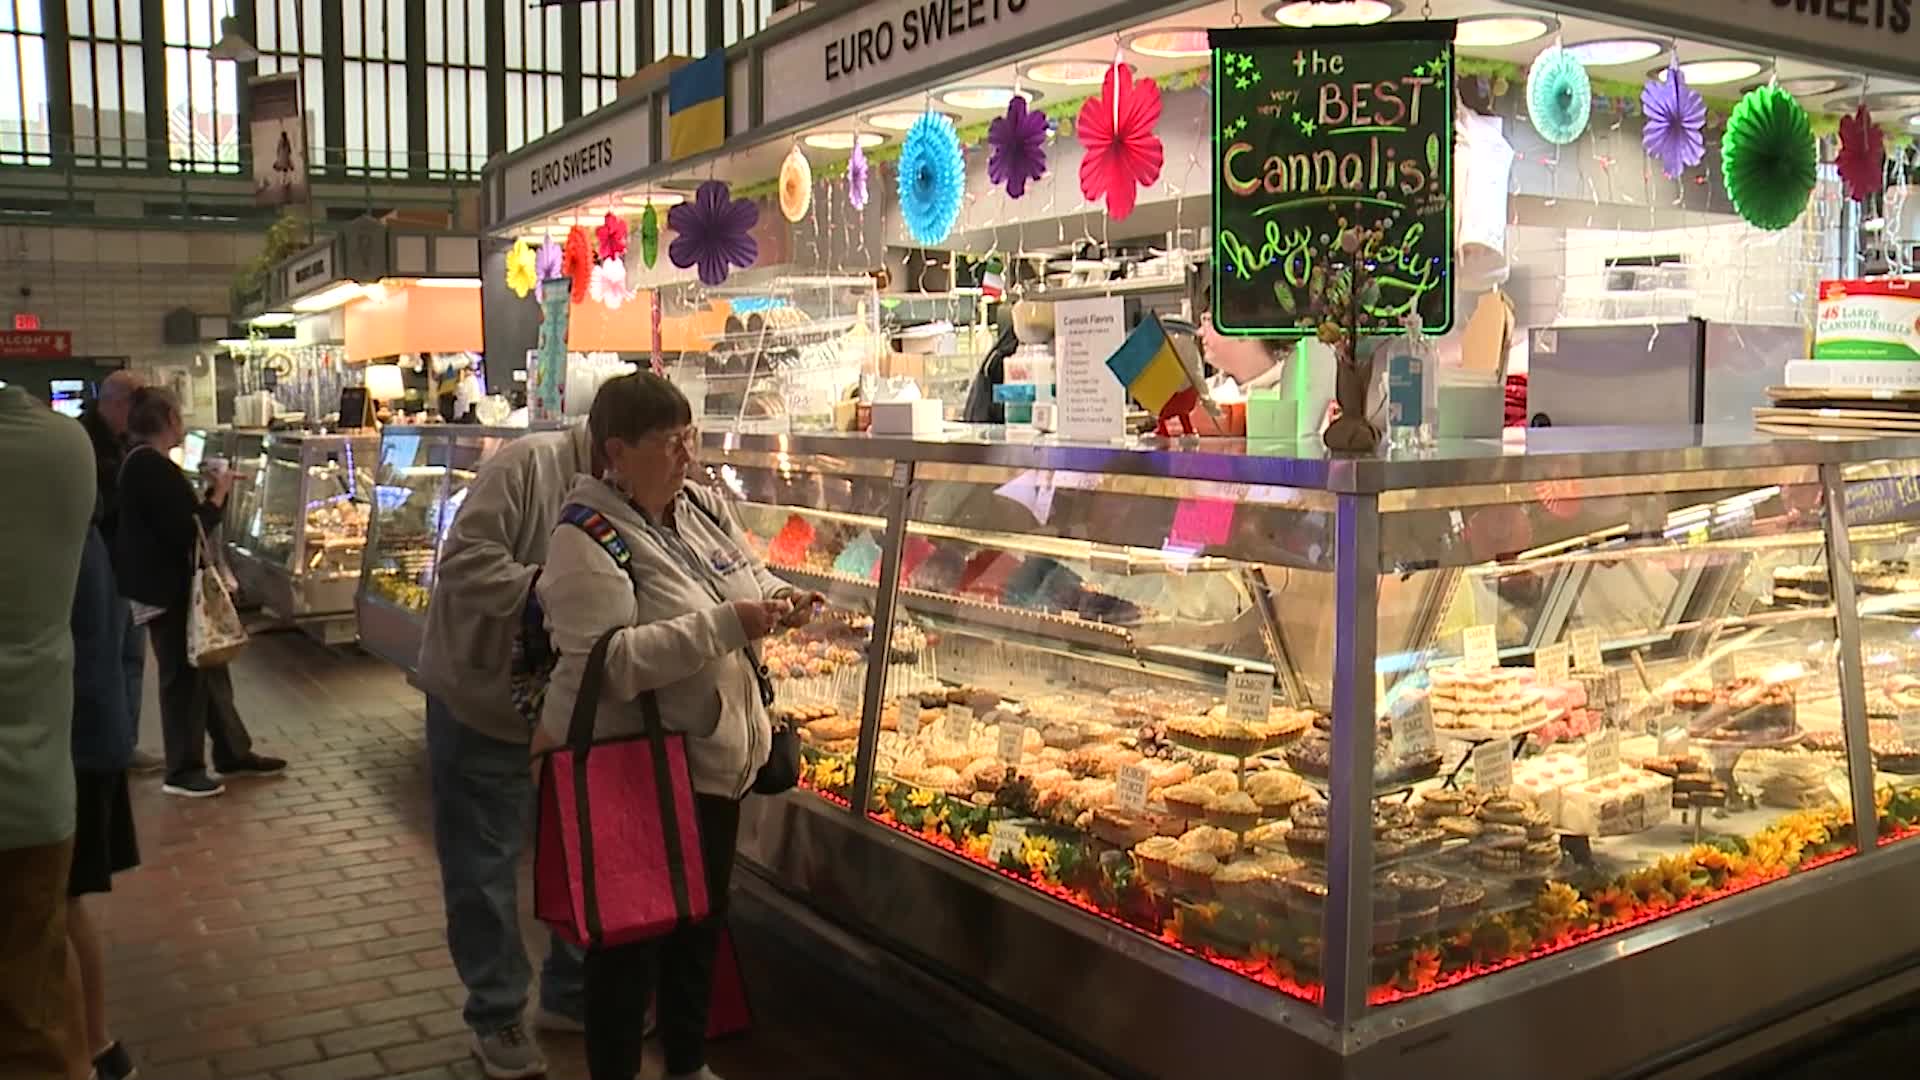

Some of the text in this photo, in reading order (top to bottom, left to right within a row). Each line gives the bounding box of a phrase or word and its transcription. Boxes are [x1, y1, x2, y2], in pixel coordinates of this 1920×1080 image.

[825, 0, 1026, 81] EURO SWEE
[1293, 50, 1345, 77] the
[1256, 104, 1283, 118] very
[1269, 77, 1435, 126] very BEST
[530, 137, 612, 195] EURO SWEETS
[1223, 132, 1441, 195] Cannolis!
[1220, 220, 1312, 287] holy
[1821, 305, 1839, 320] 48
